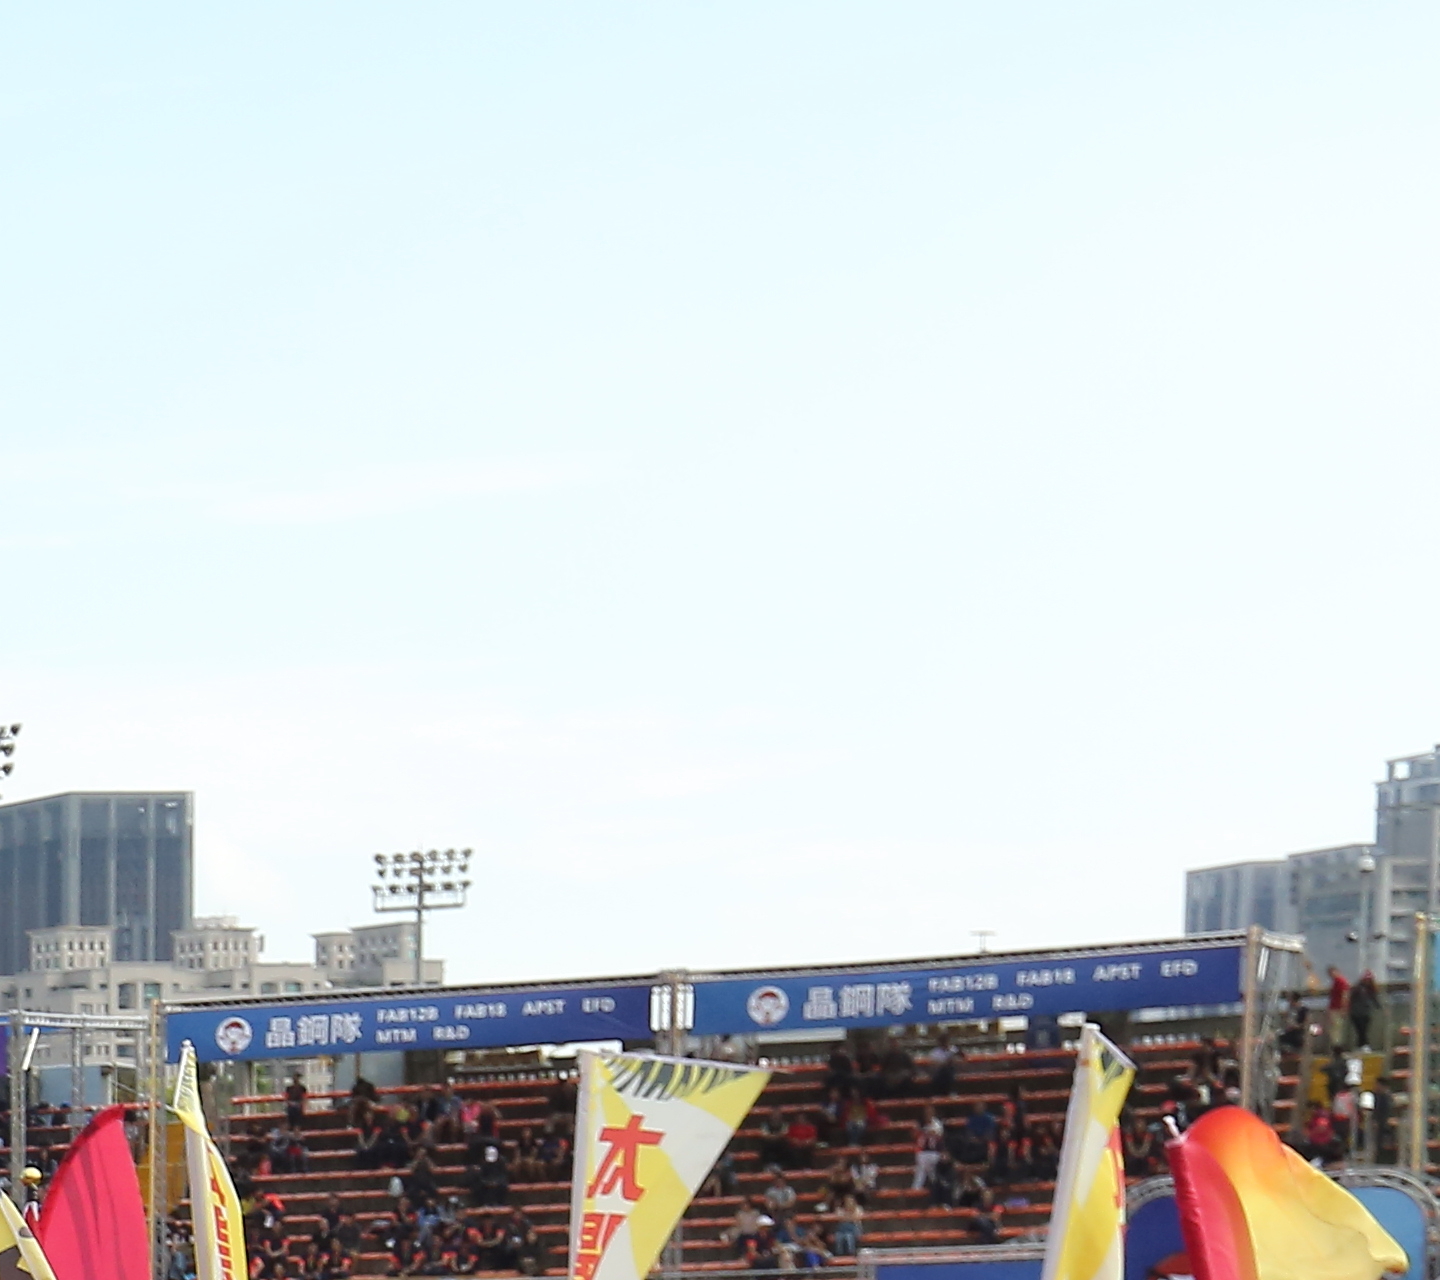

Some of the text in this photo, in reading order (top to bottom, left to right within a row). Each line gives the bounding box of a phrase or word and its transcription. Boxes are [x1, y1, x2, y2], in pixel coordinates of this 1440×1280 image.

[802, 980, 914, 1019] 晶鋼隊
[265, 1012, 364, 1049] 晶鋼隊
[432, 1025, 471, 1041] R&D
